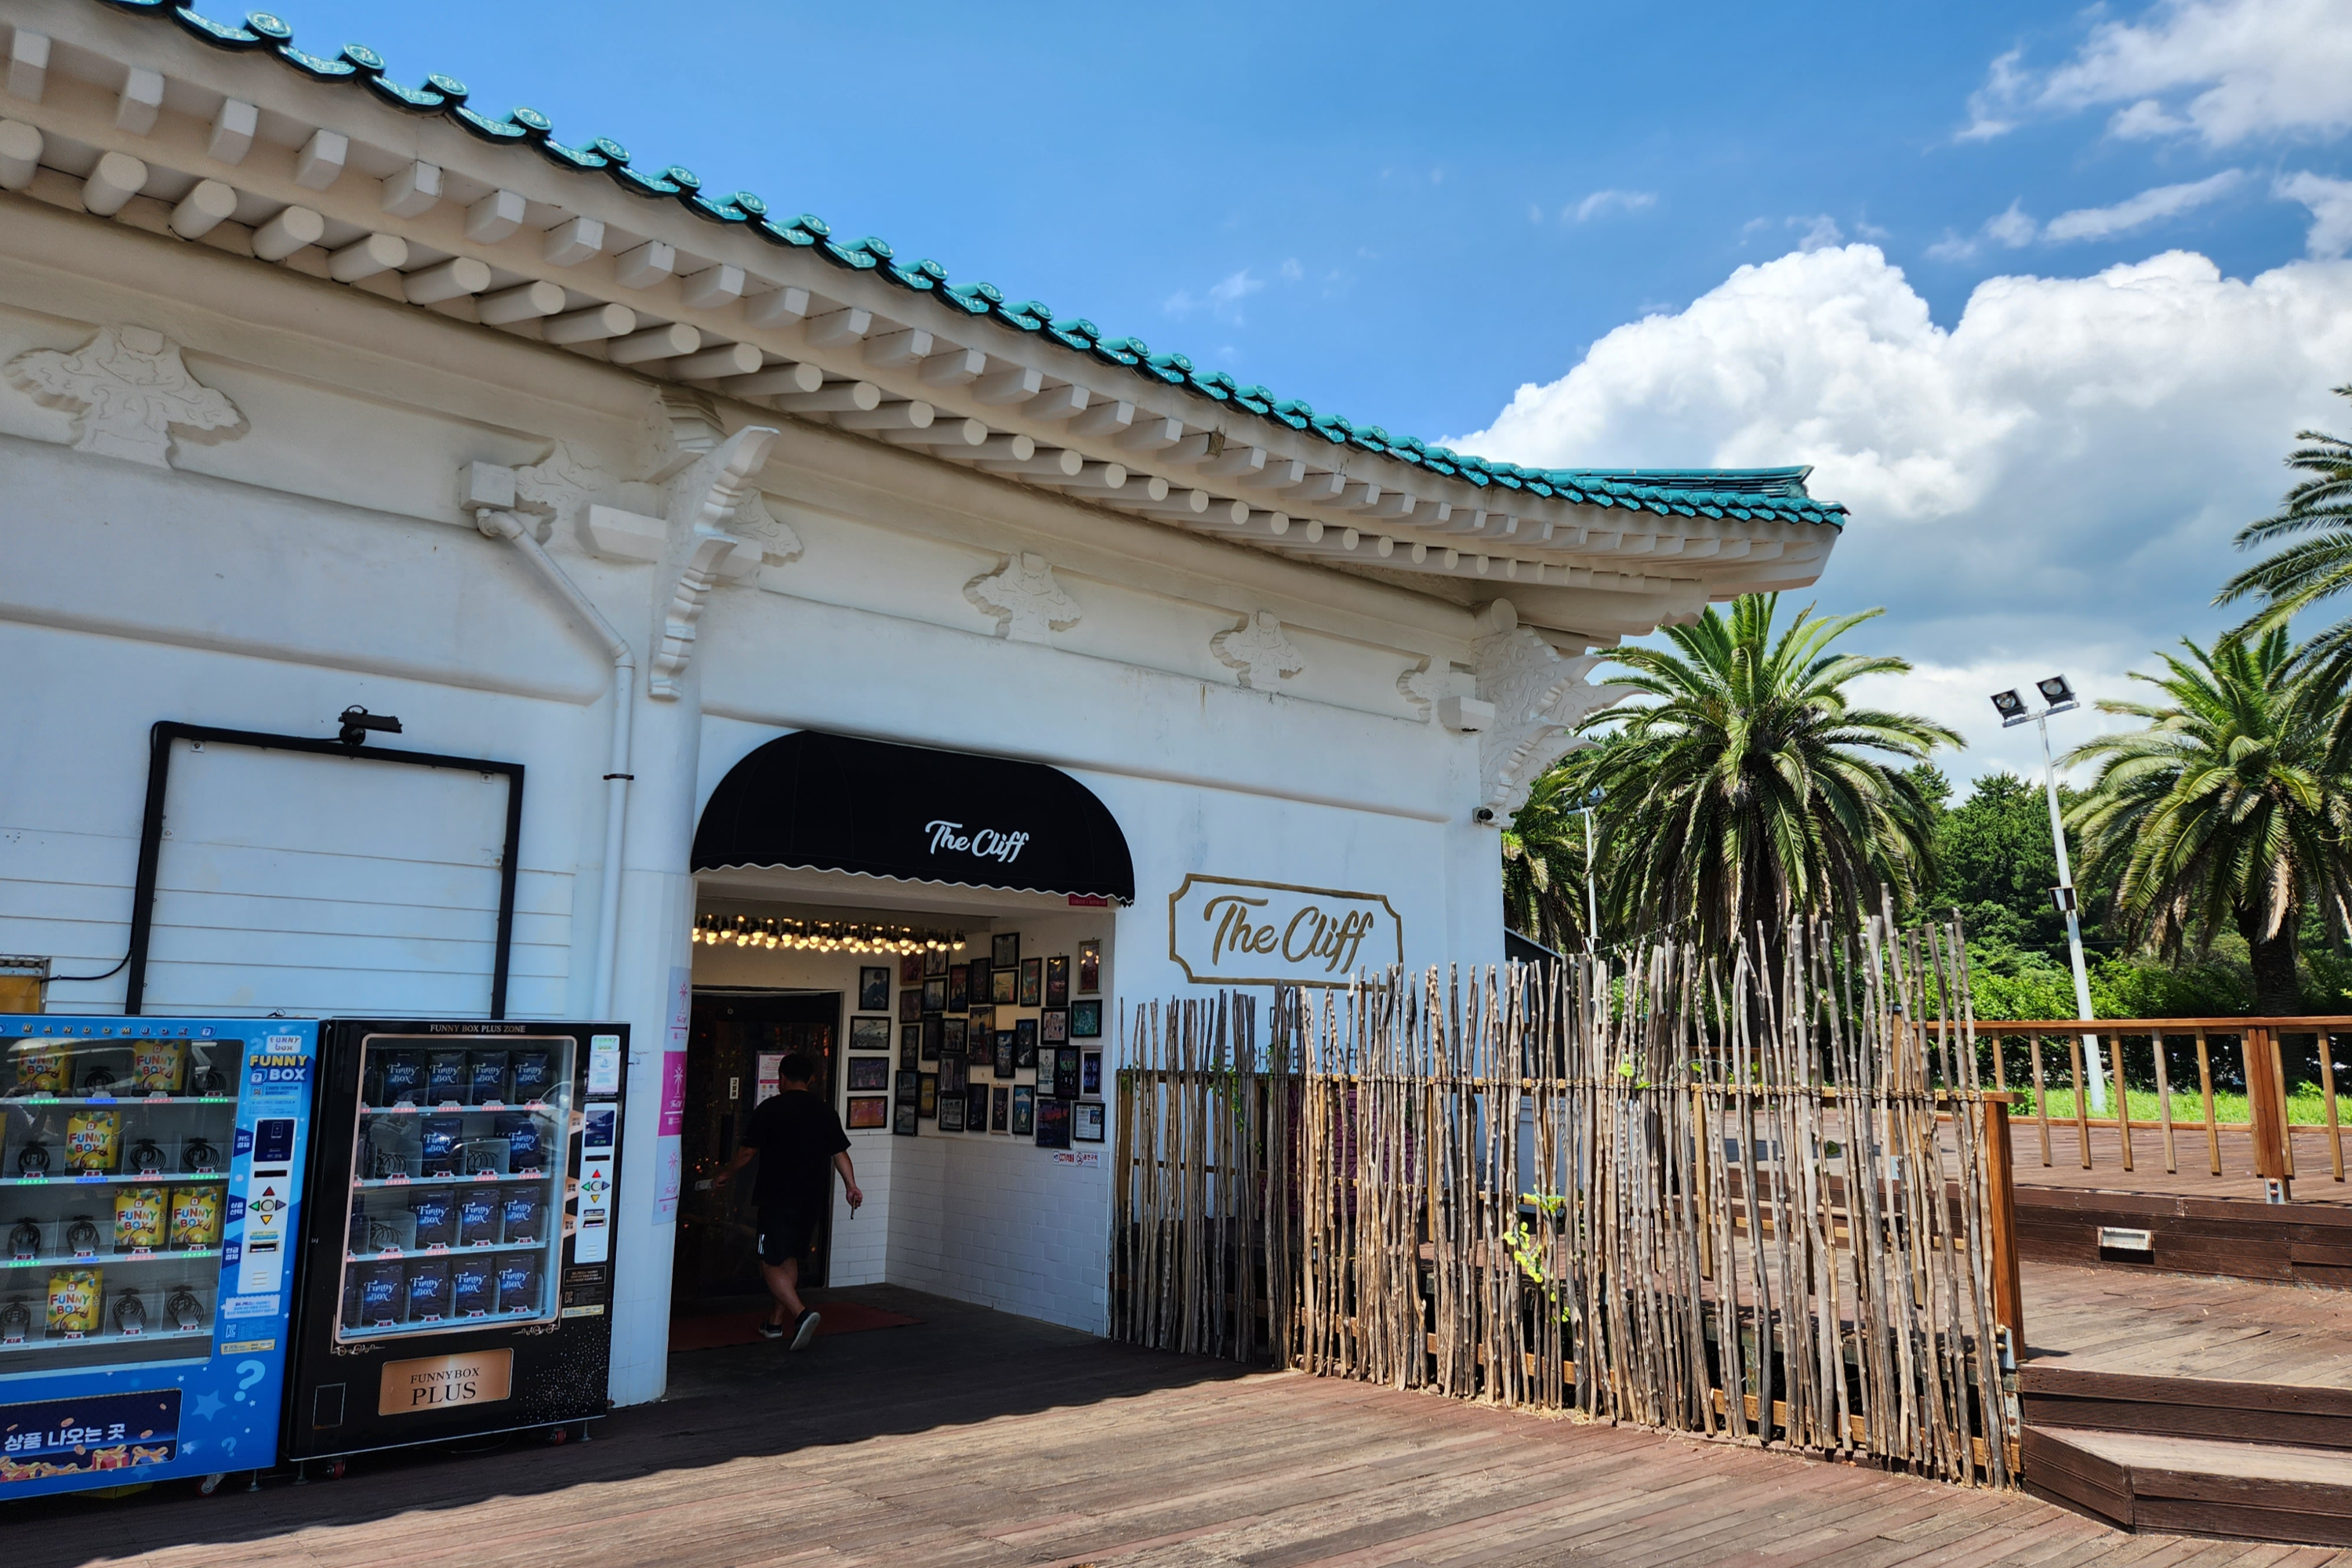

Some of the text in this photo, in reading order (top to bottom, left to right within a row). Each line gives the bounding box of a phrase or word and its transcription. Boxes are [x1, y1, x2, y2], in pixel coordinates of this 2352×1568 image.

[924, 819, 1029, 863] The Cliff
[1203, 895, 1374, 975] The Cliff
[23, 1023, 190, 1036] RANDOM BOX
[430, 1024, 459, 1033] FUNNY
[481, 1025, 502, 1033] PLUS
[20, 1054, 62, 1066] FUNNY
[136, 1054, 176, 1067] FUNNY
[249, 1055, 308, 1066] FUNNY
[143, 1065, 166, 1076] BOX
[269, 1069, 307, 1080] BOX
[387, 1062, 419, 1076] Funny
[429, 1062, 462, 1076] Funny
[473, 1062, 503, 1076] Funny
[515, 1062, 547, 1075] Funny
[68, 1133, 110, 1144] FUNNY
[75, 1143, 99, 1153] BOX
[417, 1203, 449, 1217] Funny
[462, 1201, 493, 1215] Funny
[504, 1199, 535, 1213] Funny
[117, 1210, 158, 1221] FUNNY
[173, 1207, 213, 1219] FUNNY
[466, 1214, 487, 1224] BOX
[510, 1211, 529, 1221] BOX
[124, 1221, 148, 1232] BOX
[180, 1218, 203, 1229] BOX
[422, 1216, 443, 1225] BOX
[455, 1271, 487, 1285] Funny
[499, 1268, 530, 1282] Funny
[364, 1279, 397, 1293] Funny
[410, 1275, 442, 1289] Funny
[504, 1279, 524, 1290] BOX
[416, 1287, 436, 1298] BOX
[460, 1283, 480, 1294] BOX
[50, 1294, 91, 1305] FUNNY
[370, 1292, 390, 1302] BOX
[56, 1305, 81, 1316] BOX
[410, 1381, 477, 1406] PLUS
[5, 1423, 125, 1452] 상품 나오는 곳
